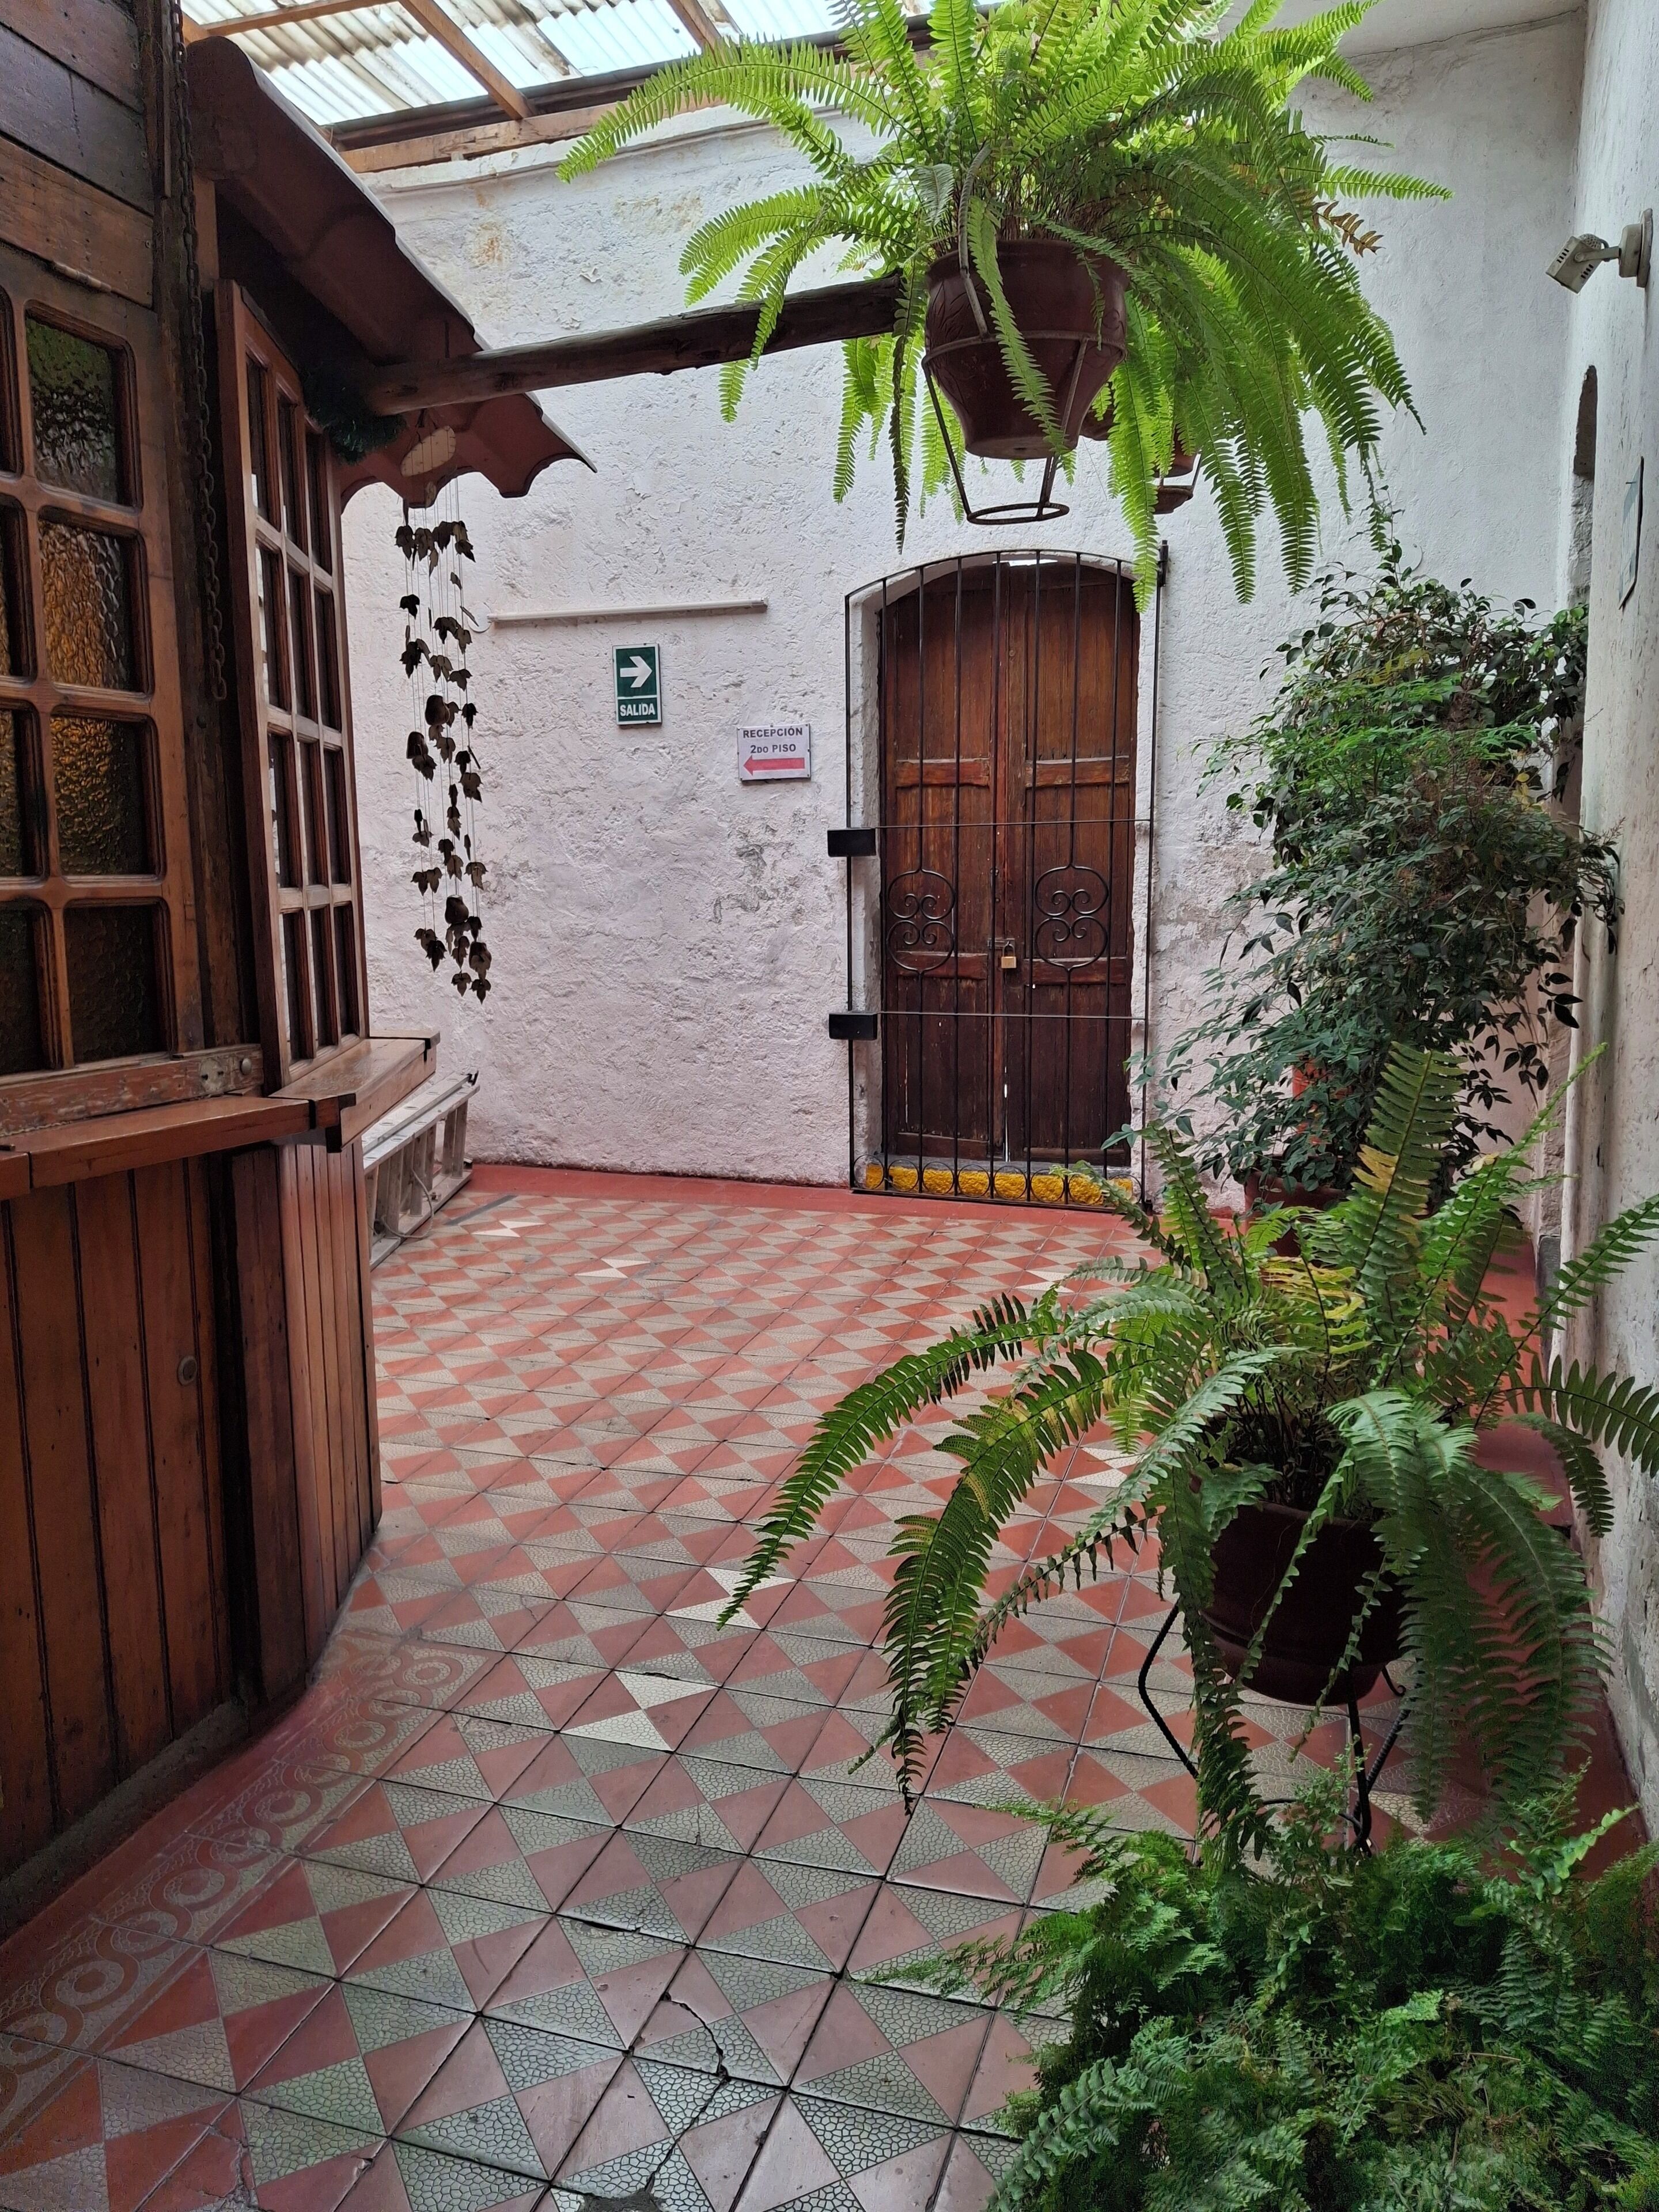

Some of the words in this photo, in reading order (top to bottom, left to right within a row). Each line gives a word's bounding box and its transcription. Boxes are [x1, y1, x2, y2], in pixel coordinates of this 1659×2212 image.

[620, 703, 656, 717] SALIDA
[743, 726, 803, 738] RECEPCIÓN
[772, 744, 797, 753] PISO
